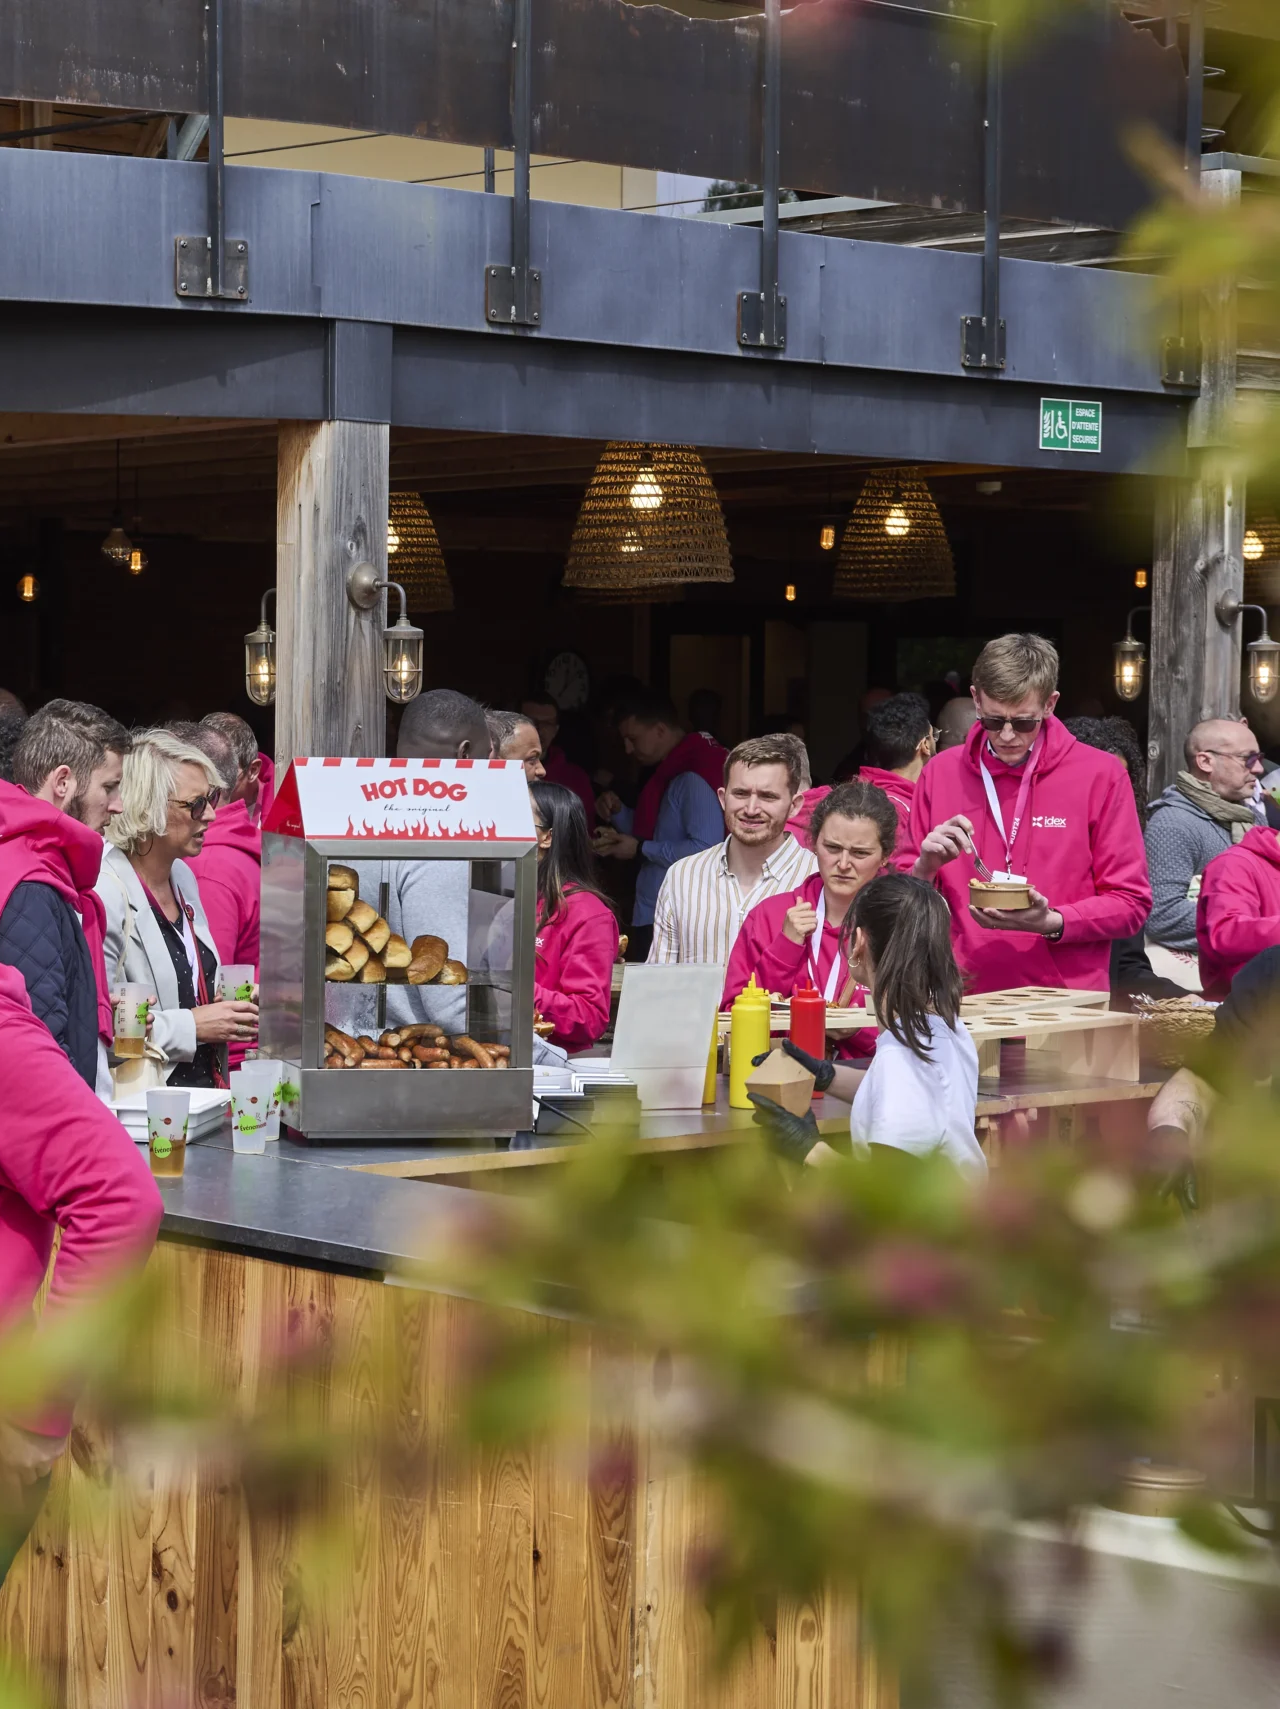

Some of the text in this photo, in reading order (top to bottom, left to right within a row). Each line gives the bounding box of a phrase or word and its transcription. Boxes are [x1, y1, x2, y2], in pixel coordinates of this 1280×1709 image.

[1075, 408, 1095, 417] ESPACE
[1072, 421, 1099, 431] D'ATTENTE
[360, 777, 468, 802] HOT DOG
[384, 803, 451, 816] the original
[1044, 816, 1066, 825] idex
